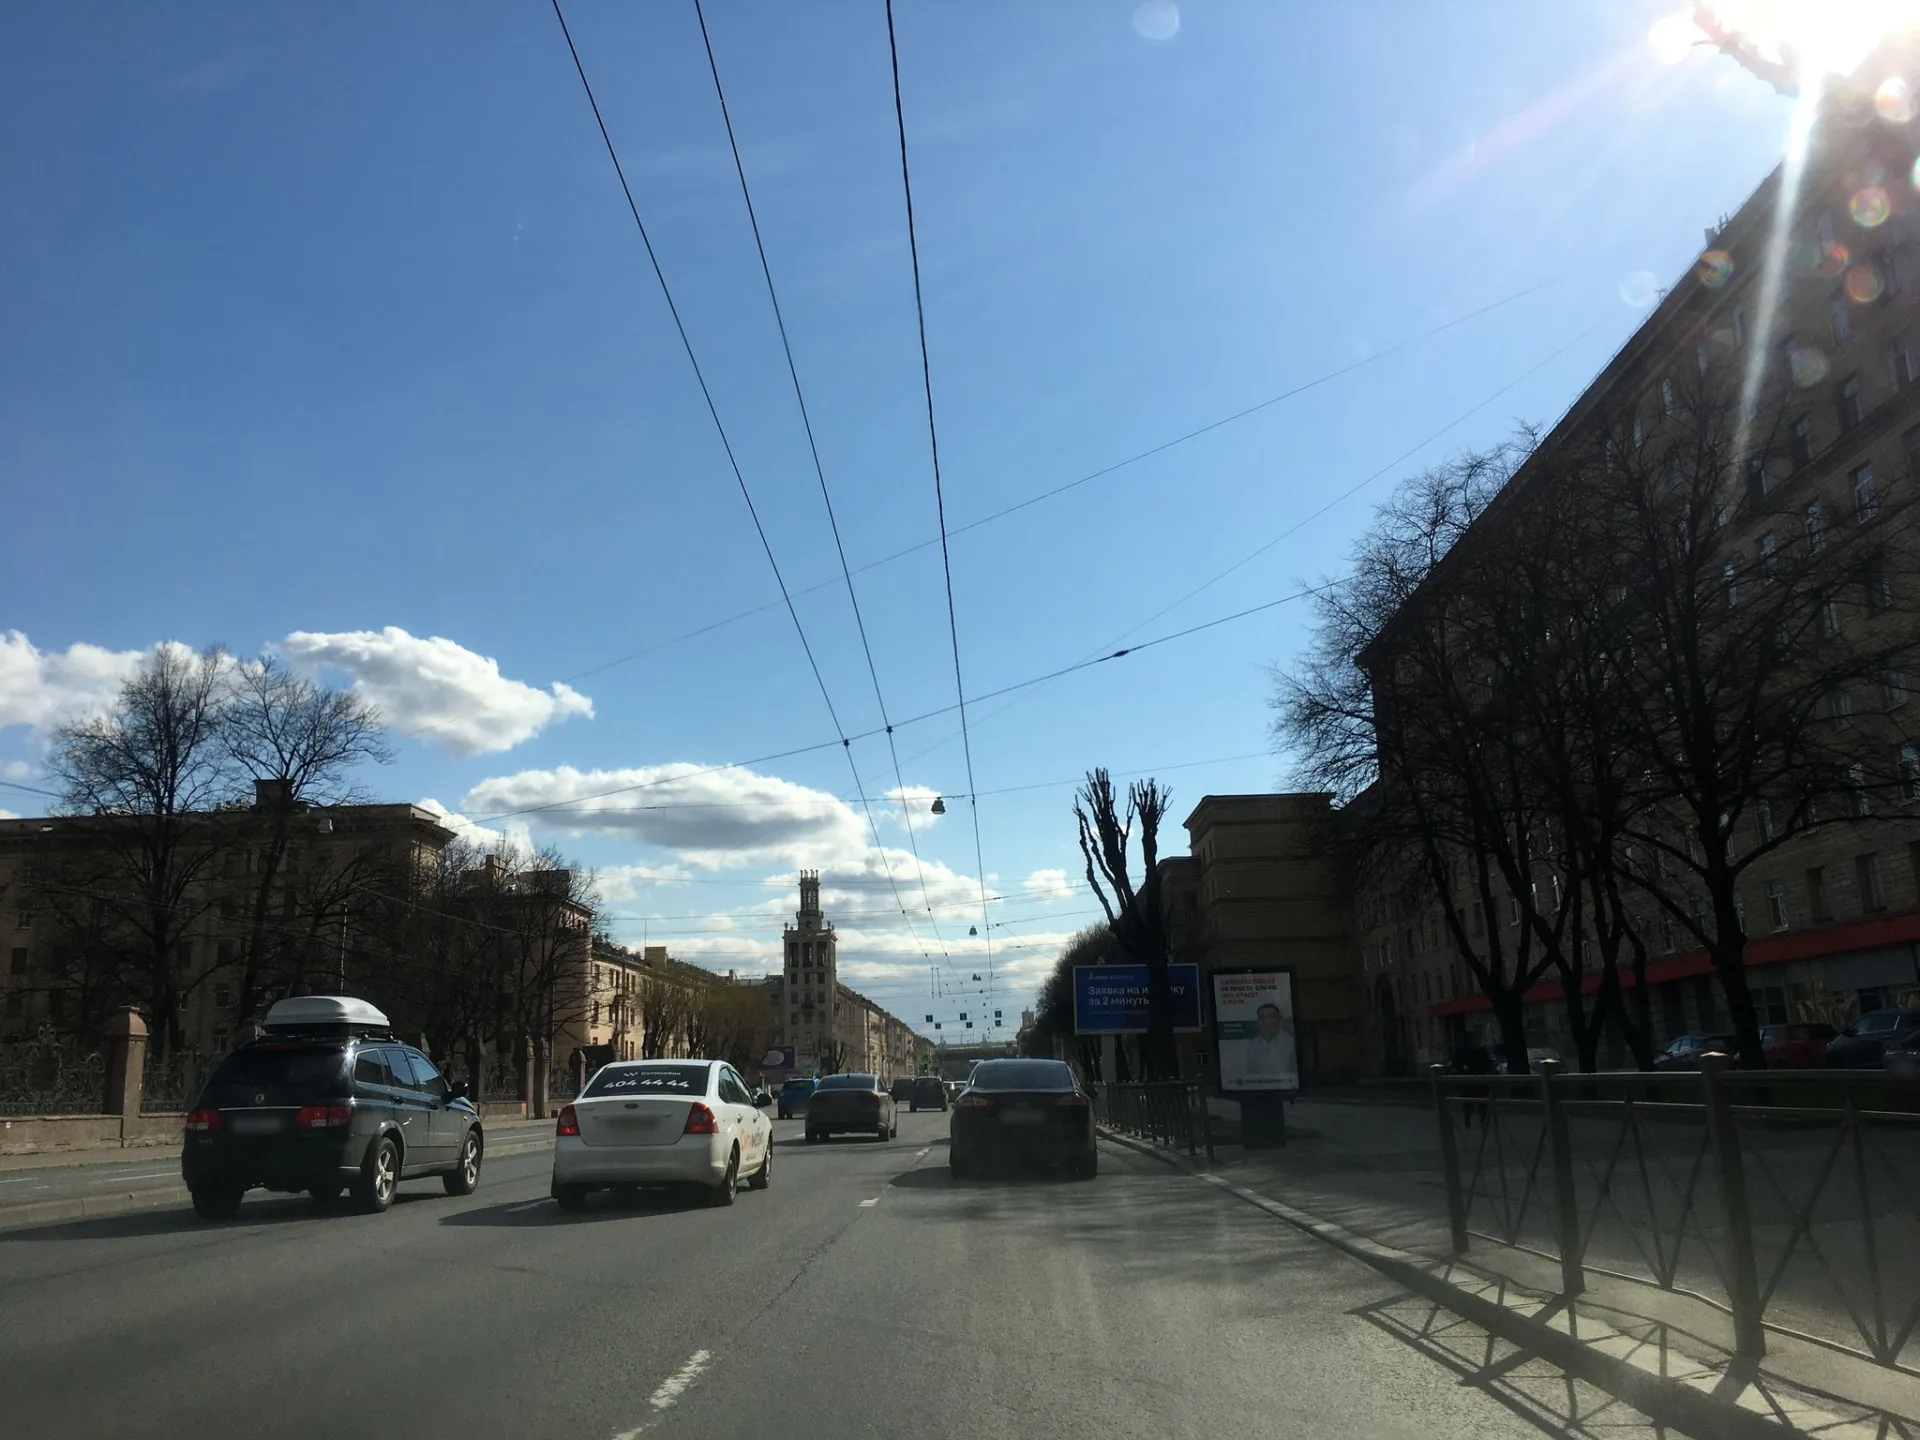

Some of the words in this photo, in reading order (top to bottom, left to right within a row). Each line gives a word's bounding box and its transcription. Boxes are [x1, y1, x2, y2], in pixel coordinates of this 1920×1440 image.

[1088, 986, 1125, 995] Заявка
[1126, 987, 1140, 995] на
[1088, 998, 1101, 1006] за
[1102, 996, 1109, 1006] 2
[603, 1079, 638, 1089] 404
[640, 1078, 664, 1086] 44
[666, 1079, 690, 1088] 44
